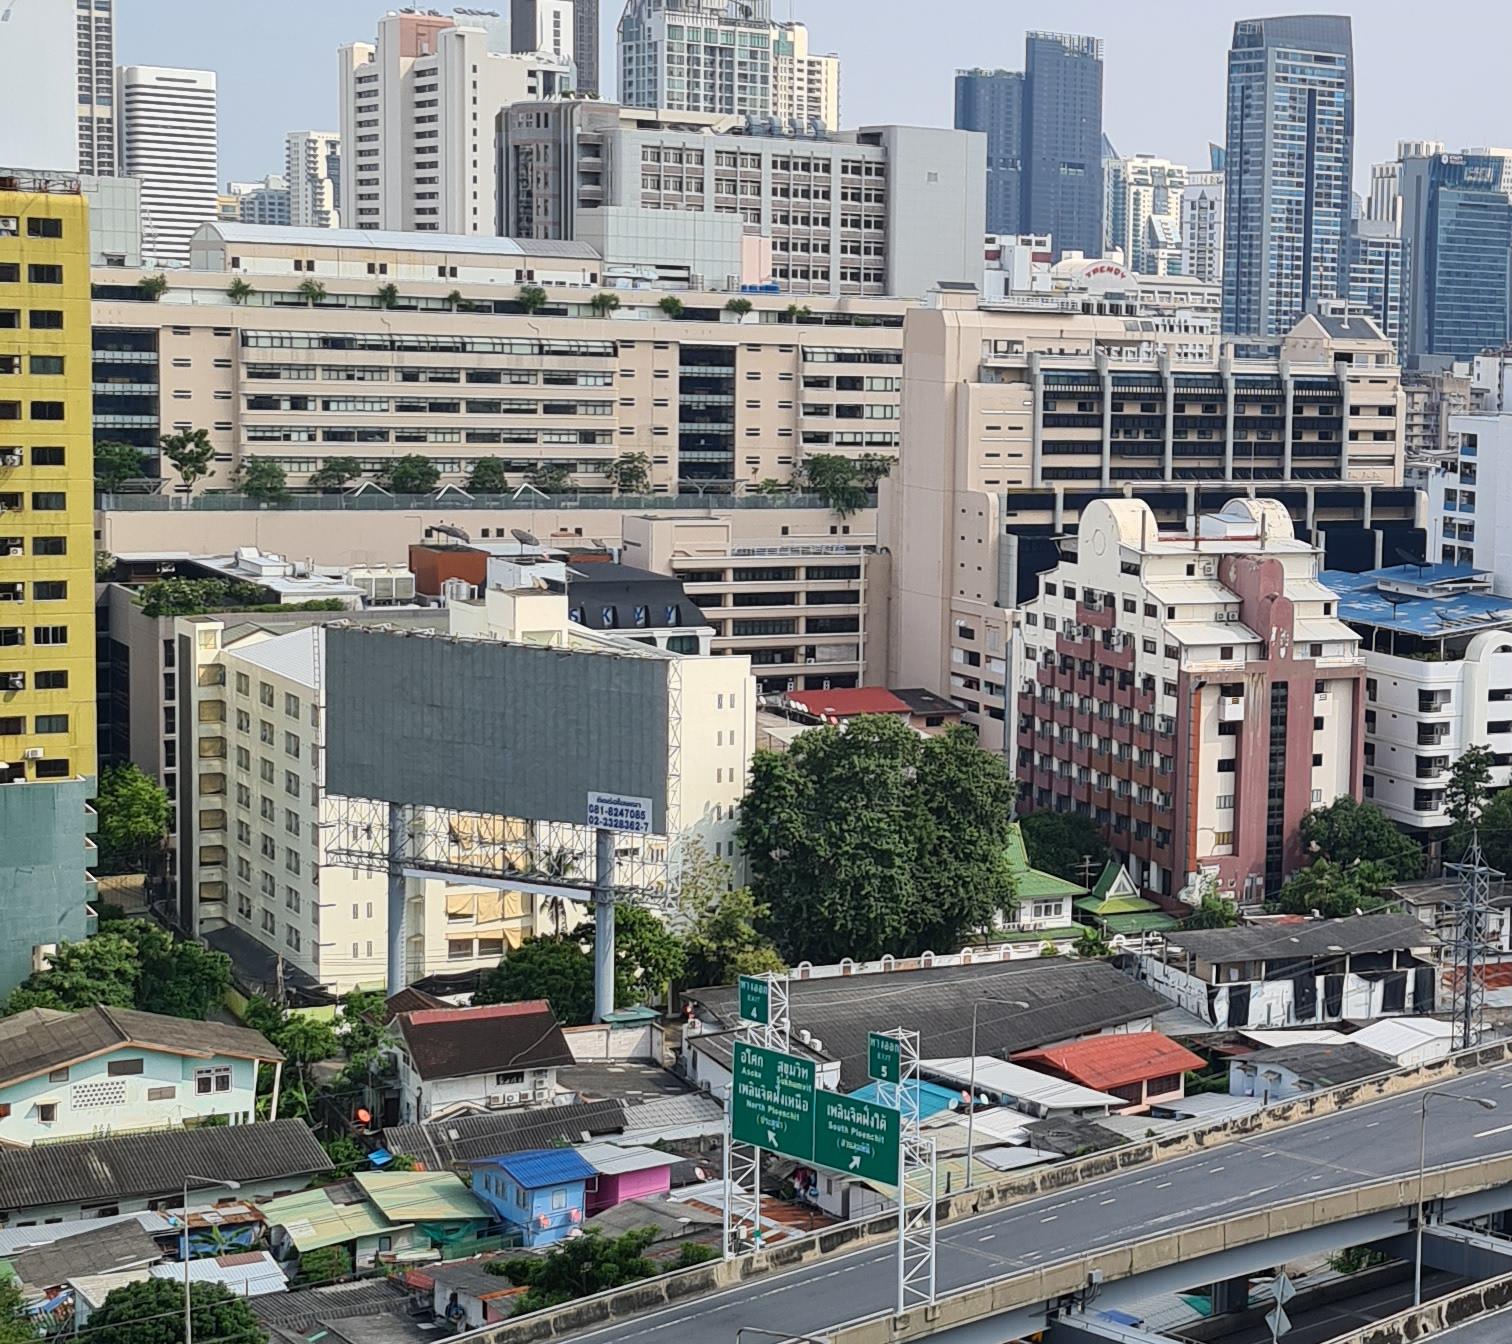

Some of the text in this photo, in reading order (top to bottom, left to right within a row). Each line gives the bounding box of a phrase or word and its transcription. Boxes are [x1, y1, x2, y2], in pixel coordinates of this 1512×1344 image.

[1085, 266, 1126, 279] TRENDY
[589, 804, 646, 820] 081-8247085
[751, 1006, 757, 1018] 4
[741, 1048, 808, 1080] อโศก สุขุมวิท
[881, 1065, 887, 1077] 5
[746, 1099, 800, 1121] North Ploenchit
[827, 1104, 887, 1131] เพลินจิตฝั่งใต้
[828, 1121, 884, 1144] South Ploenchit
